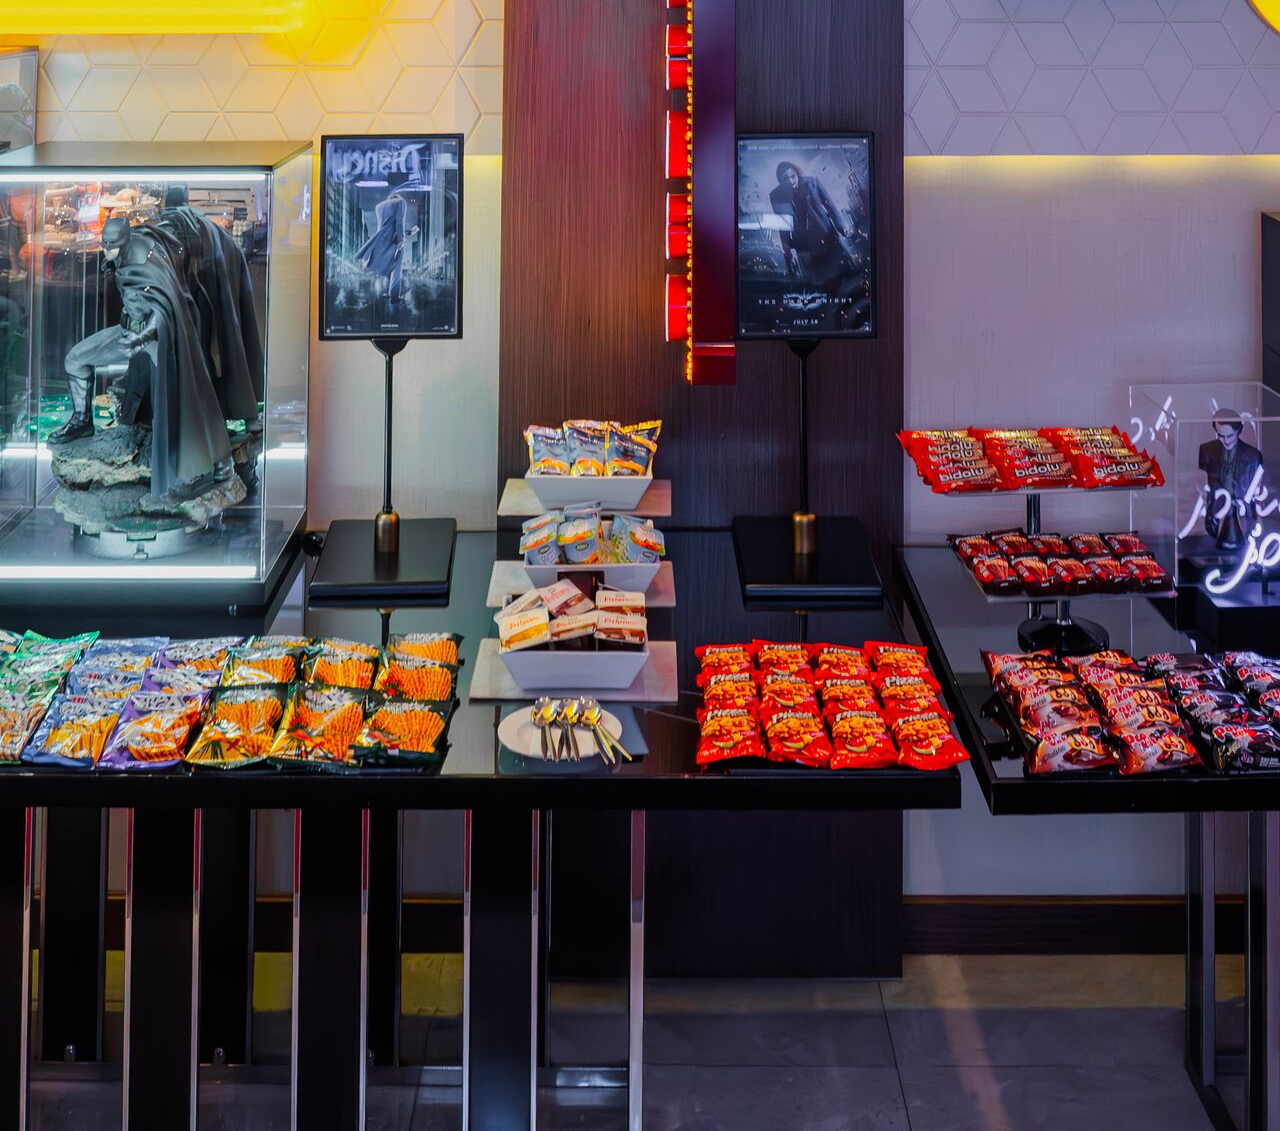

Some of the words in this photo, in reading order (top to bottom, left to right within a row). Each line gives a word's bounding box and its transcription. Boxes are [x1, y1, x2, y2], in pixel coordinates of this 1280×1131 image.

[938, 467, 984, 483] bidolu
[1014, 462, 1060, 477] bidolu
[1093, 462, 1139, 478] bidolu
